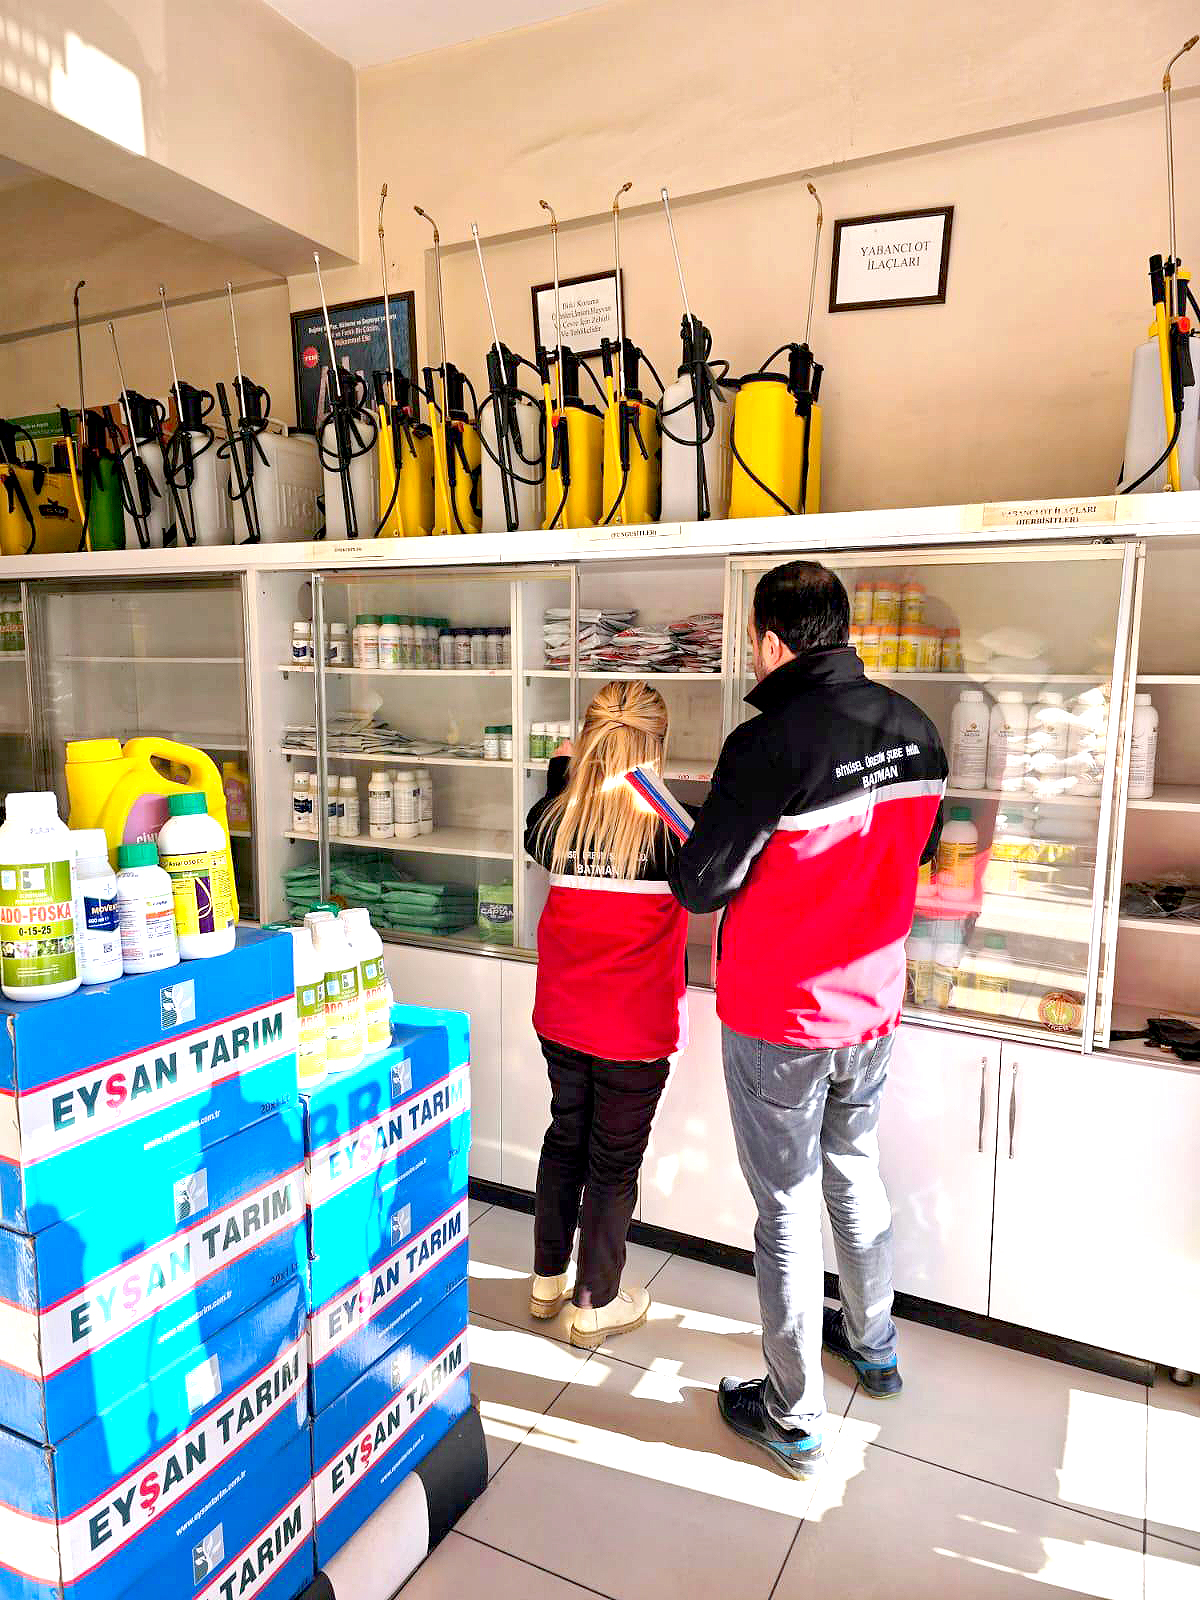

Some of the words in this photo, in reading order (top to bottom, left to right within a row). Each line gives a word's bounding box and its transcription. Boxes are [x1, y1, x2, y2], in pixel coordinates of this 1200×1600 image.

[860, 242, 911, 257] YABANCI
[914, 240, 931, 252] OT
[867, 256, 920, 271] İLAÇLARI
[862, 764, 899, 789] BATMAN
[886, 747, 904, 763] ŞUBE
[0, 902, 72, 924] ADO-FOSKA
[19, 925, 52, 937] 0-15-25
[52, 1051, 178, 1132] EYŞAN
[189, 1012, 283, 1074] TARIM
[408, 1077, 464, 1131] TARIM
[70, 1242, 192, 1344] EYŞAN
[202, 1183, 293, 1261] TARIM
[406, 1211, 461, 1274] TARIM
[331, 1404, 401, 1494] EYŞAN
[407, 1342, 463, 1414] TARIM
[89, 1430, 207, 1552] EYŞAN
[216, 1352, 300, 1446] TARIM
[219, 1504, 302, 1600] TARIM
